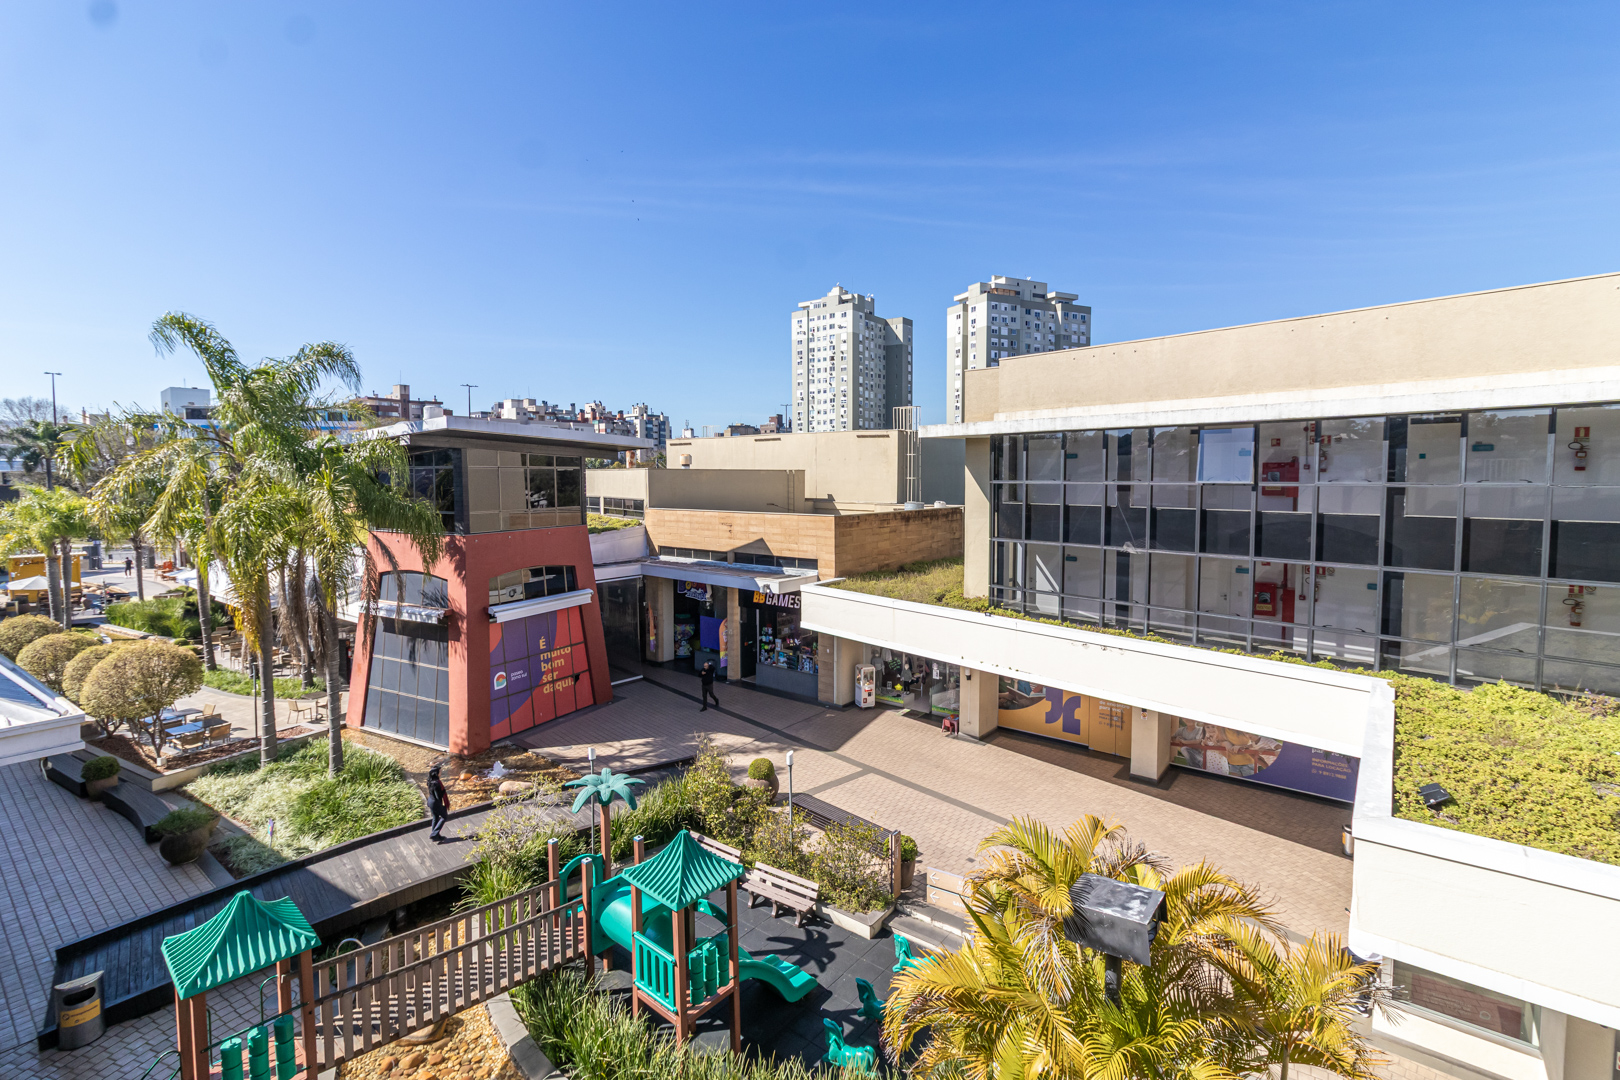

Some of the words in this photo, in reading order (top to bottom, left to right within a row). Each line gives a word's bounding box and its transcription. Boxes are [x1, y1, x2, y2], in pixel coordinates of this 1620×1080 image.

[765, 592, 801, 609] GAMES
[539, 636, 547, 650] É
[540, 646, 571, 661] muito
[541, 658, 565, 672] bom
[542, 671, 559, 683] ser
